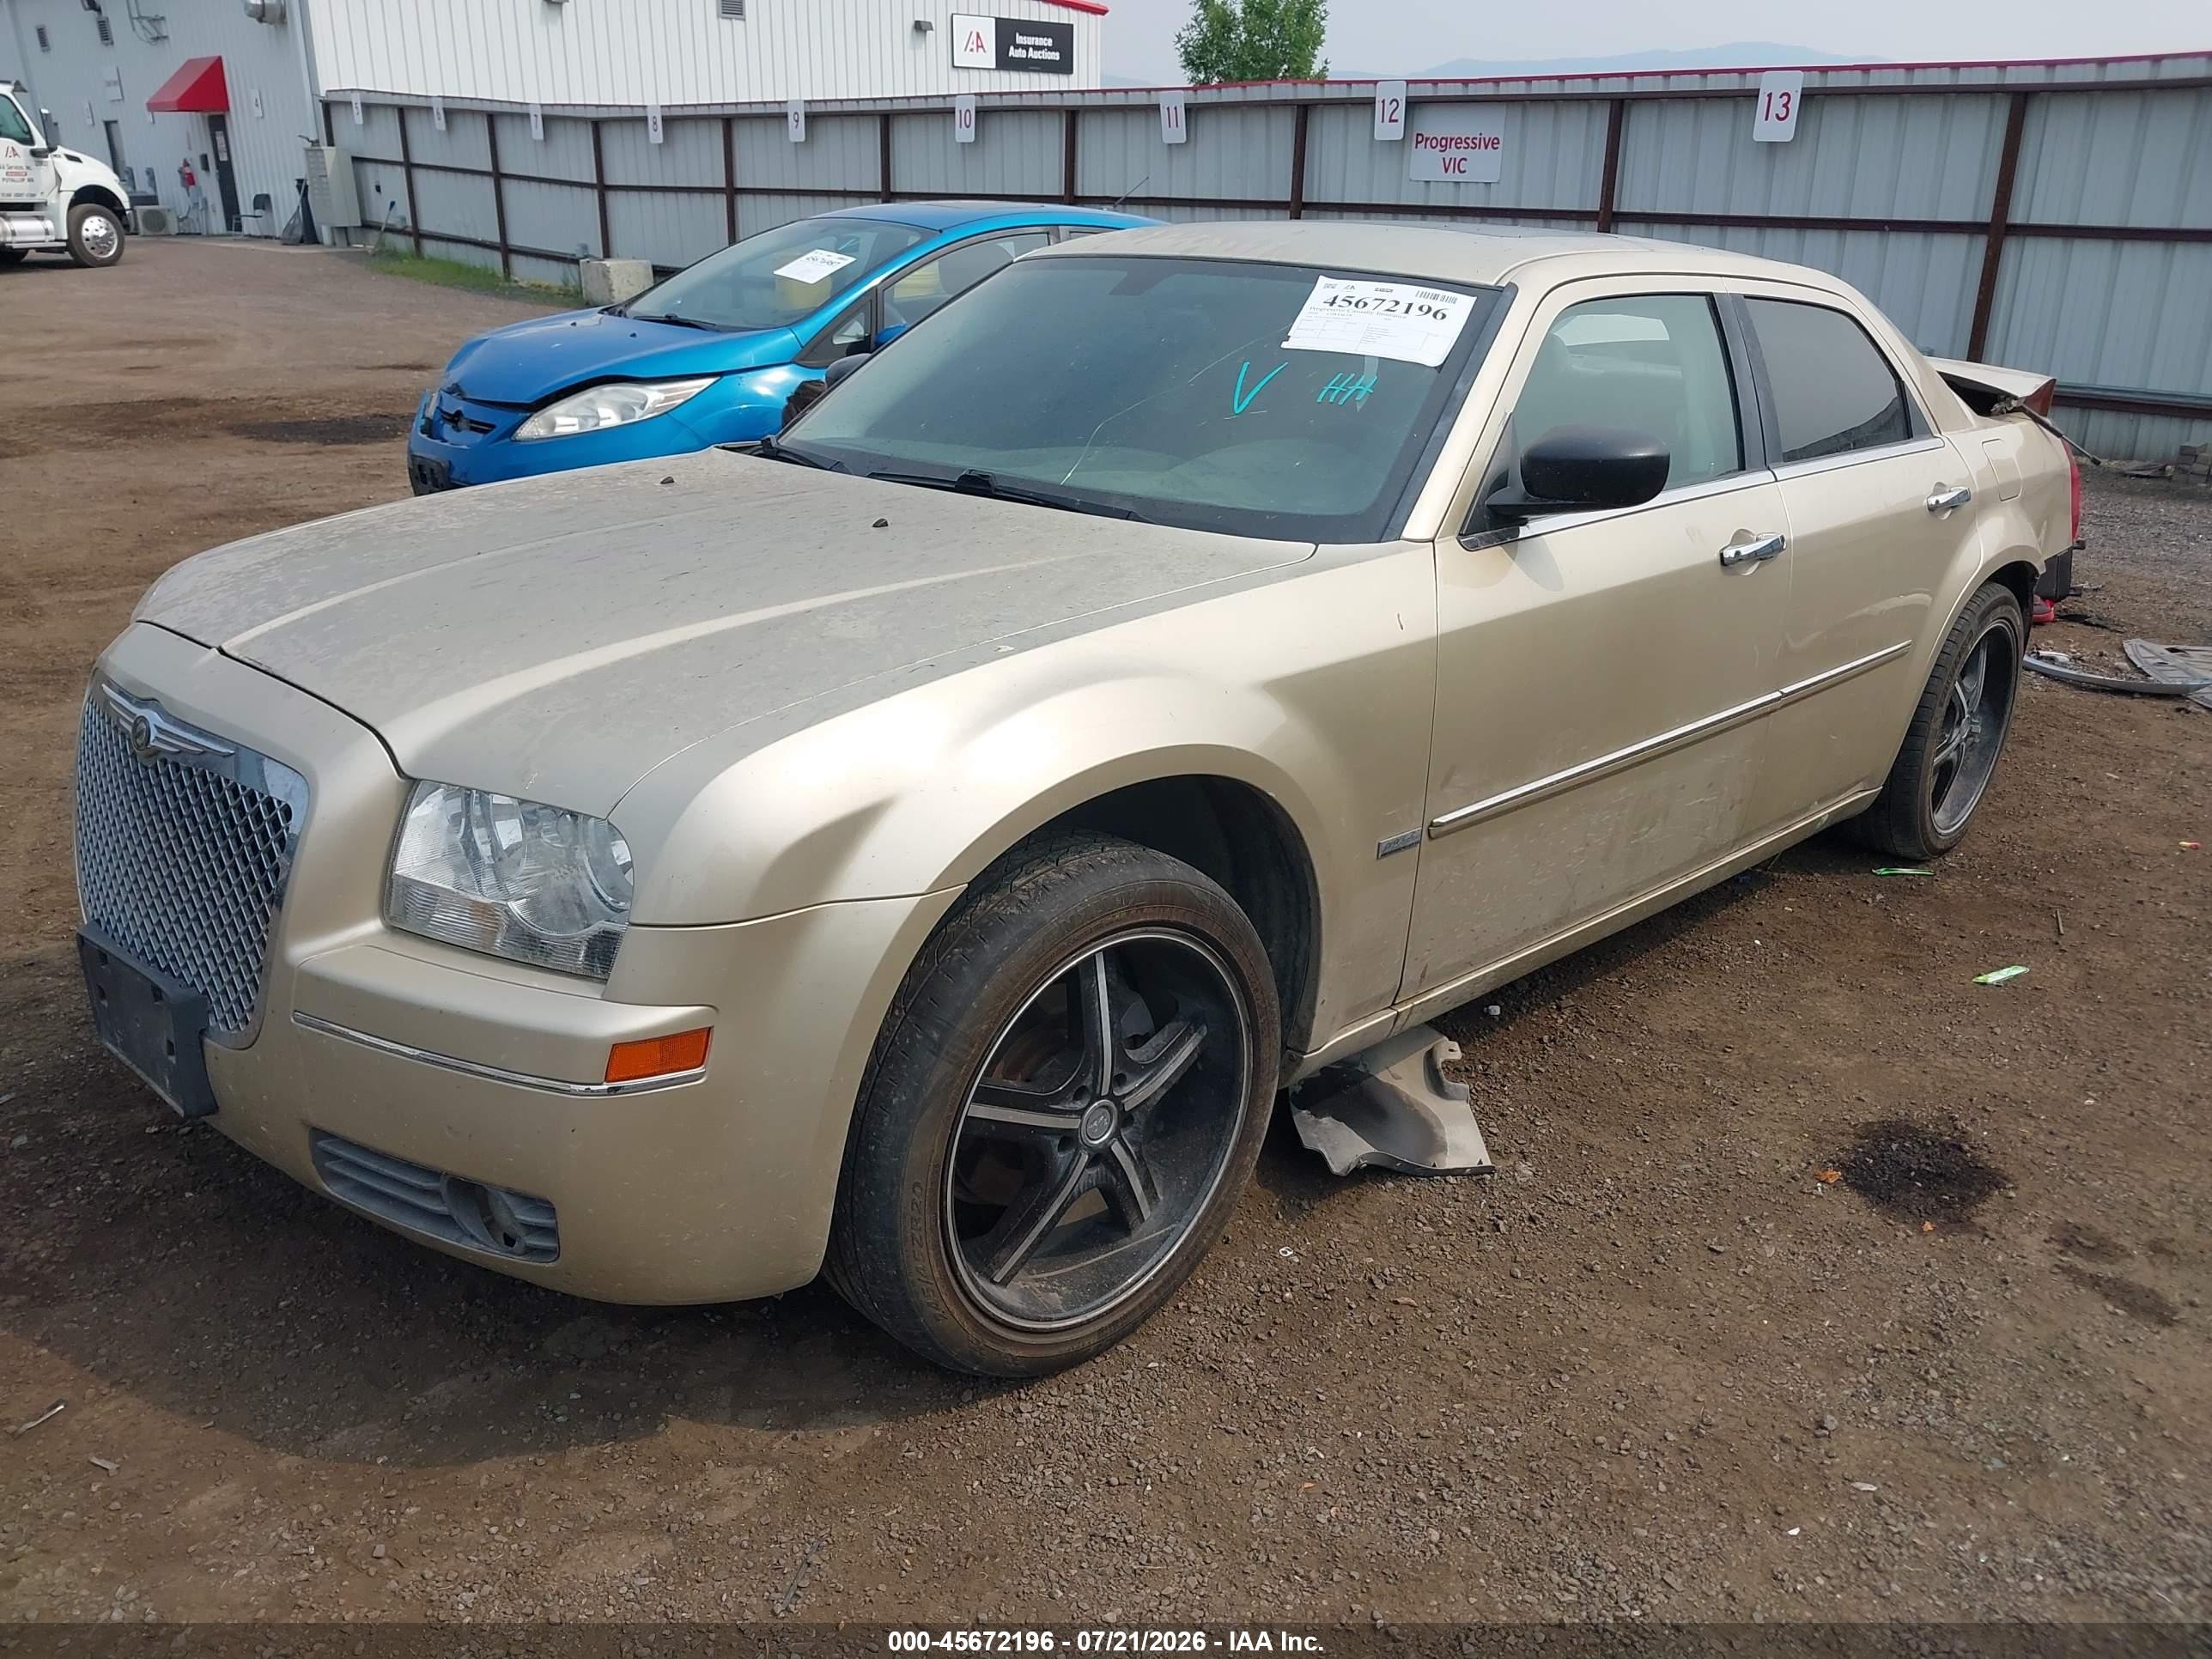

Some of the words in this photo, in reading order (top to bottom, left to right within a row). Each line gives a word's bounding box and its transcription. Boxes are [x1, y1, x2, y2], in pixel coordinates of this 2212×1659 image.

[1016, 32, 1053, 46] Insurance
[1008, 46, 1026, 58] Auto
[1028, 46, 1060, 61] Auctions
[1379, 98, 1400, 125] 12
[1764, 91, 1791, 122] 13
[533, 113, 539, 130] 7
[652, 115, 659, 132] 8
[793, 112, 799, 129] 9
[958, 109, 972, 130] 10
[1166, 106, 1180, 129] 11
[1414, 132, 1501, 154] Progressive
[1442, 156, 1468, 174] VIC
[1322, 294, 1449, 321] 45672196
